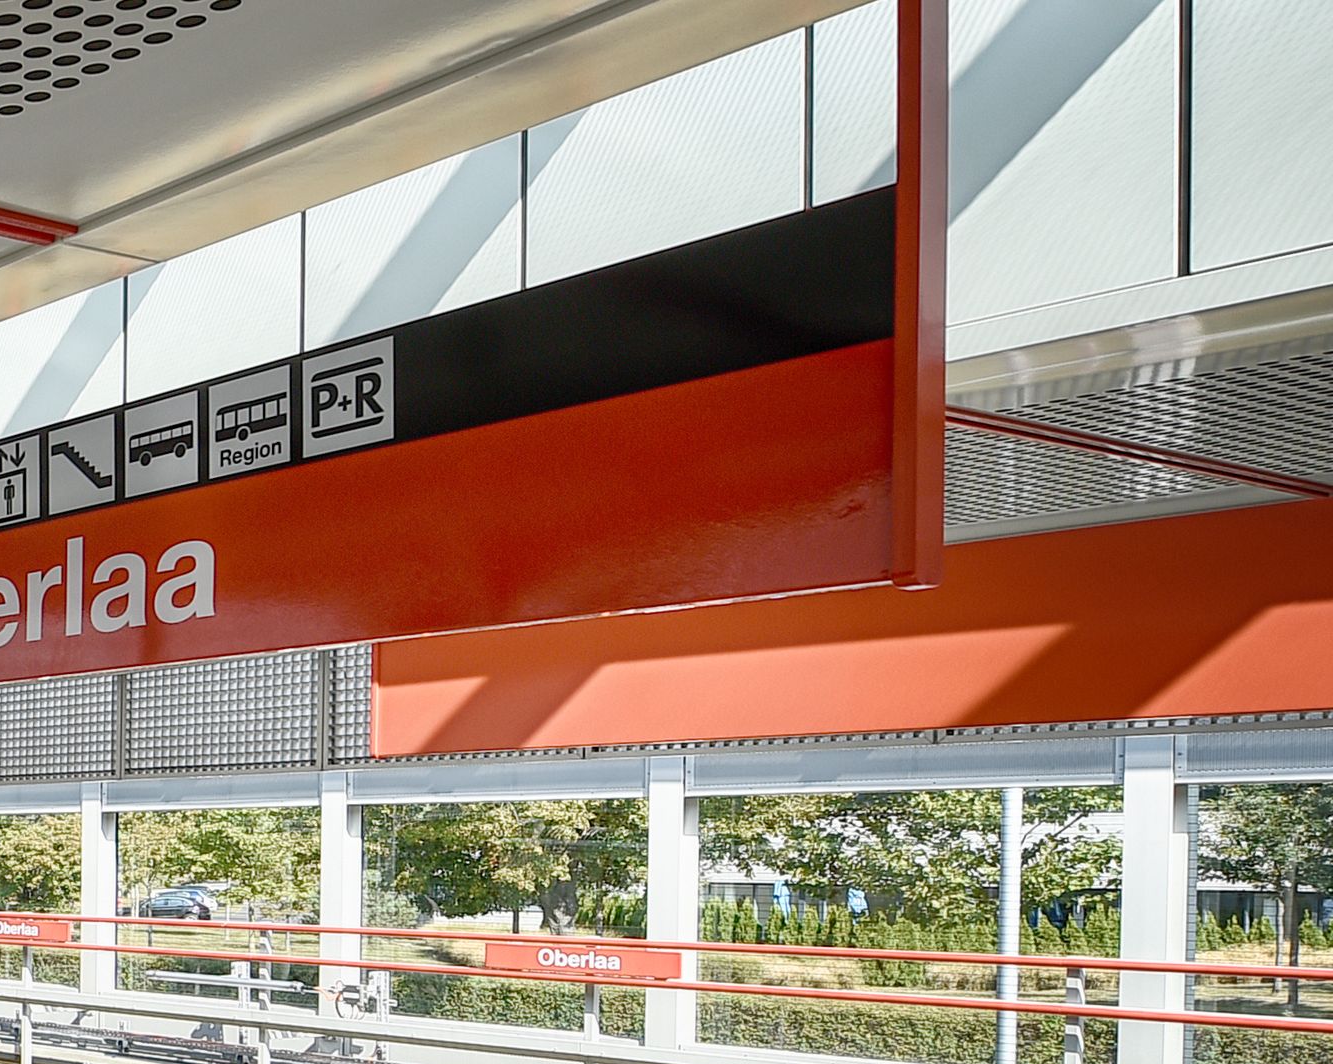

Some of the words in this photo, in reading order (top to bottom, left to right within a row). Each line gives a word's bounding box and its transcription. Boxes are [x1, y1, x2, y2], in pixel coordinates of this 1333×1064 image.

[310, 371, 385, 429] P+R
[220, 441, 282, 468] Region
[537, 948, 621, 970] Oberlaa
